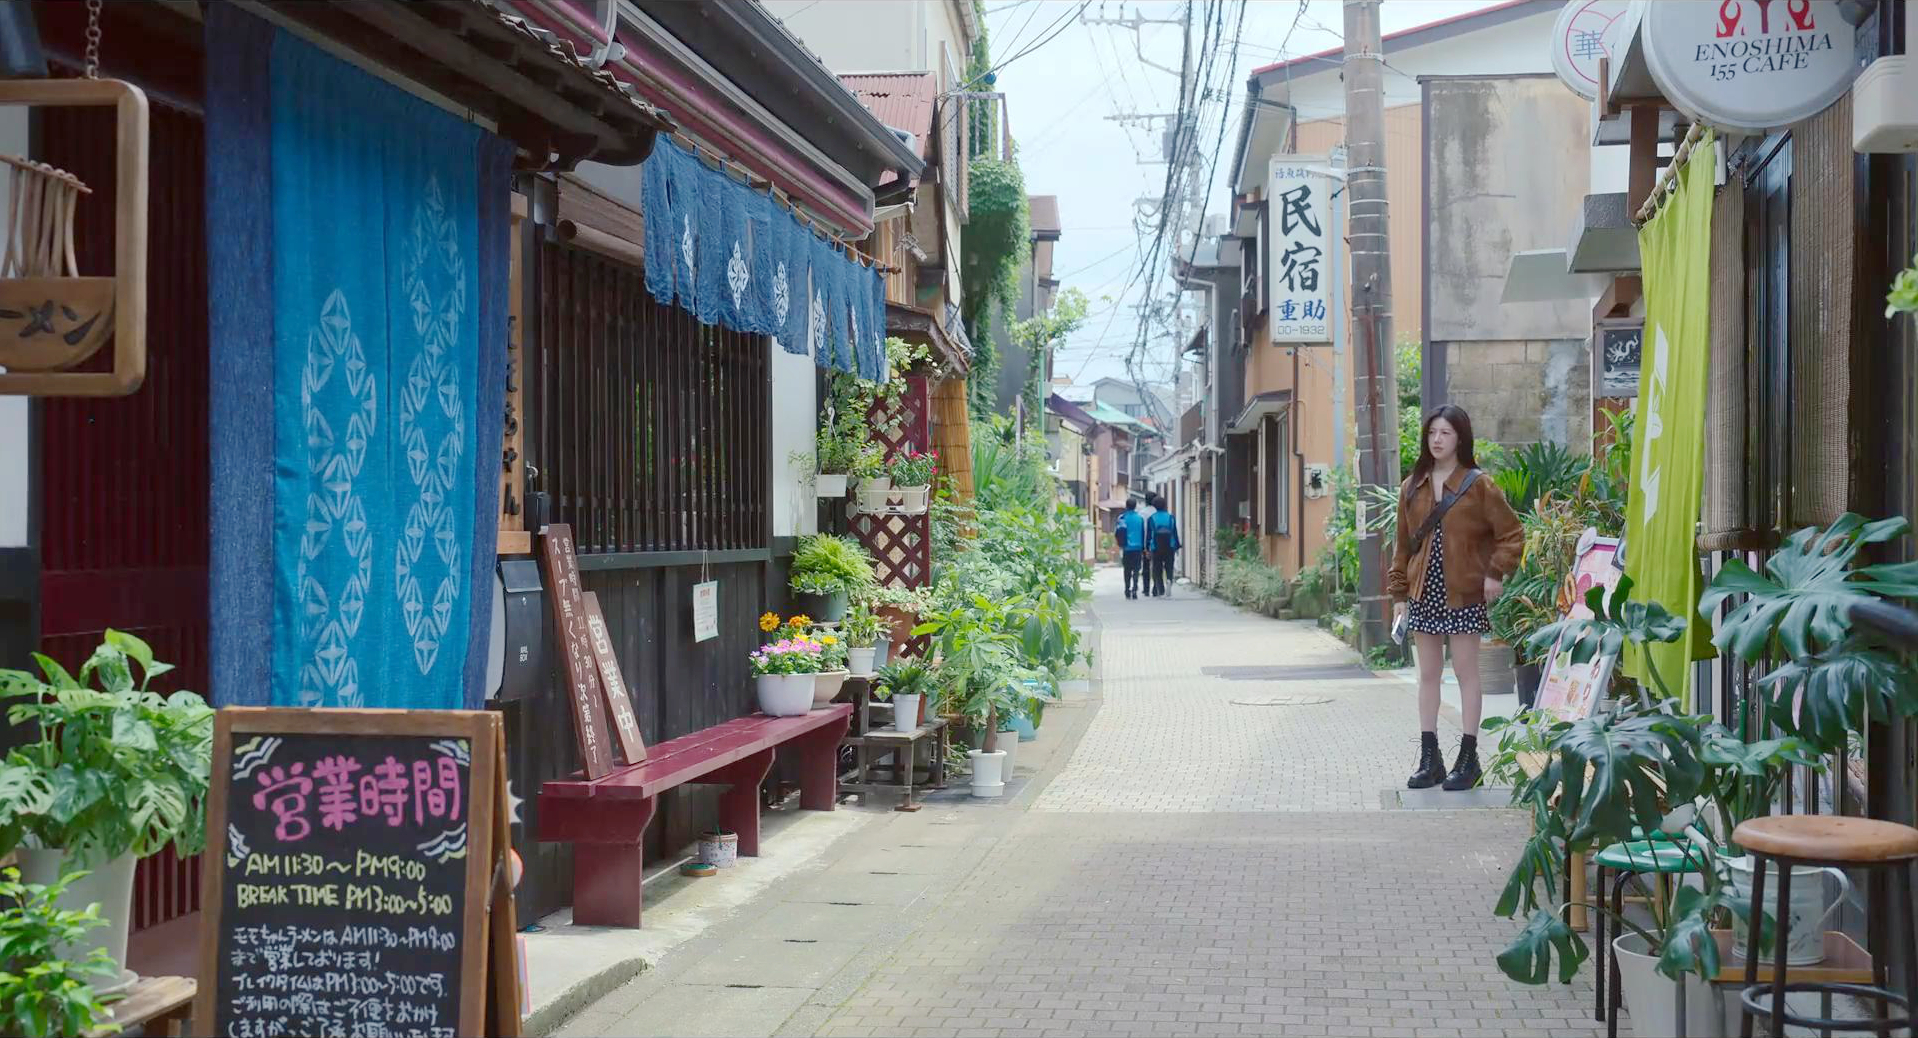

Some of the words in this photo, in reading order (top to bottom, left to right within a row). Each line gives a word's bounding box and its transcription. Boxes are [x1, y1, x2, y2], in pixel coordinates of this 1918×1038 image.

[1694, 32, 1833, 62] ENOSHIMA
[1710, 62, 1737, 81] 155
[1742, 52, 1809, 74] CAFE
[1279, 184, 1322, 293] 民宿
[1277, 299, 1326, 322] 重助
[588, 614, 635, 744] 営業中
[252, 754, 461, 841] 営業時間
[236, 883, 289, 908] BREAK
[290, 884, 340, 906] TIME
